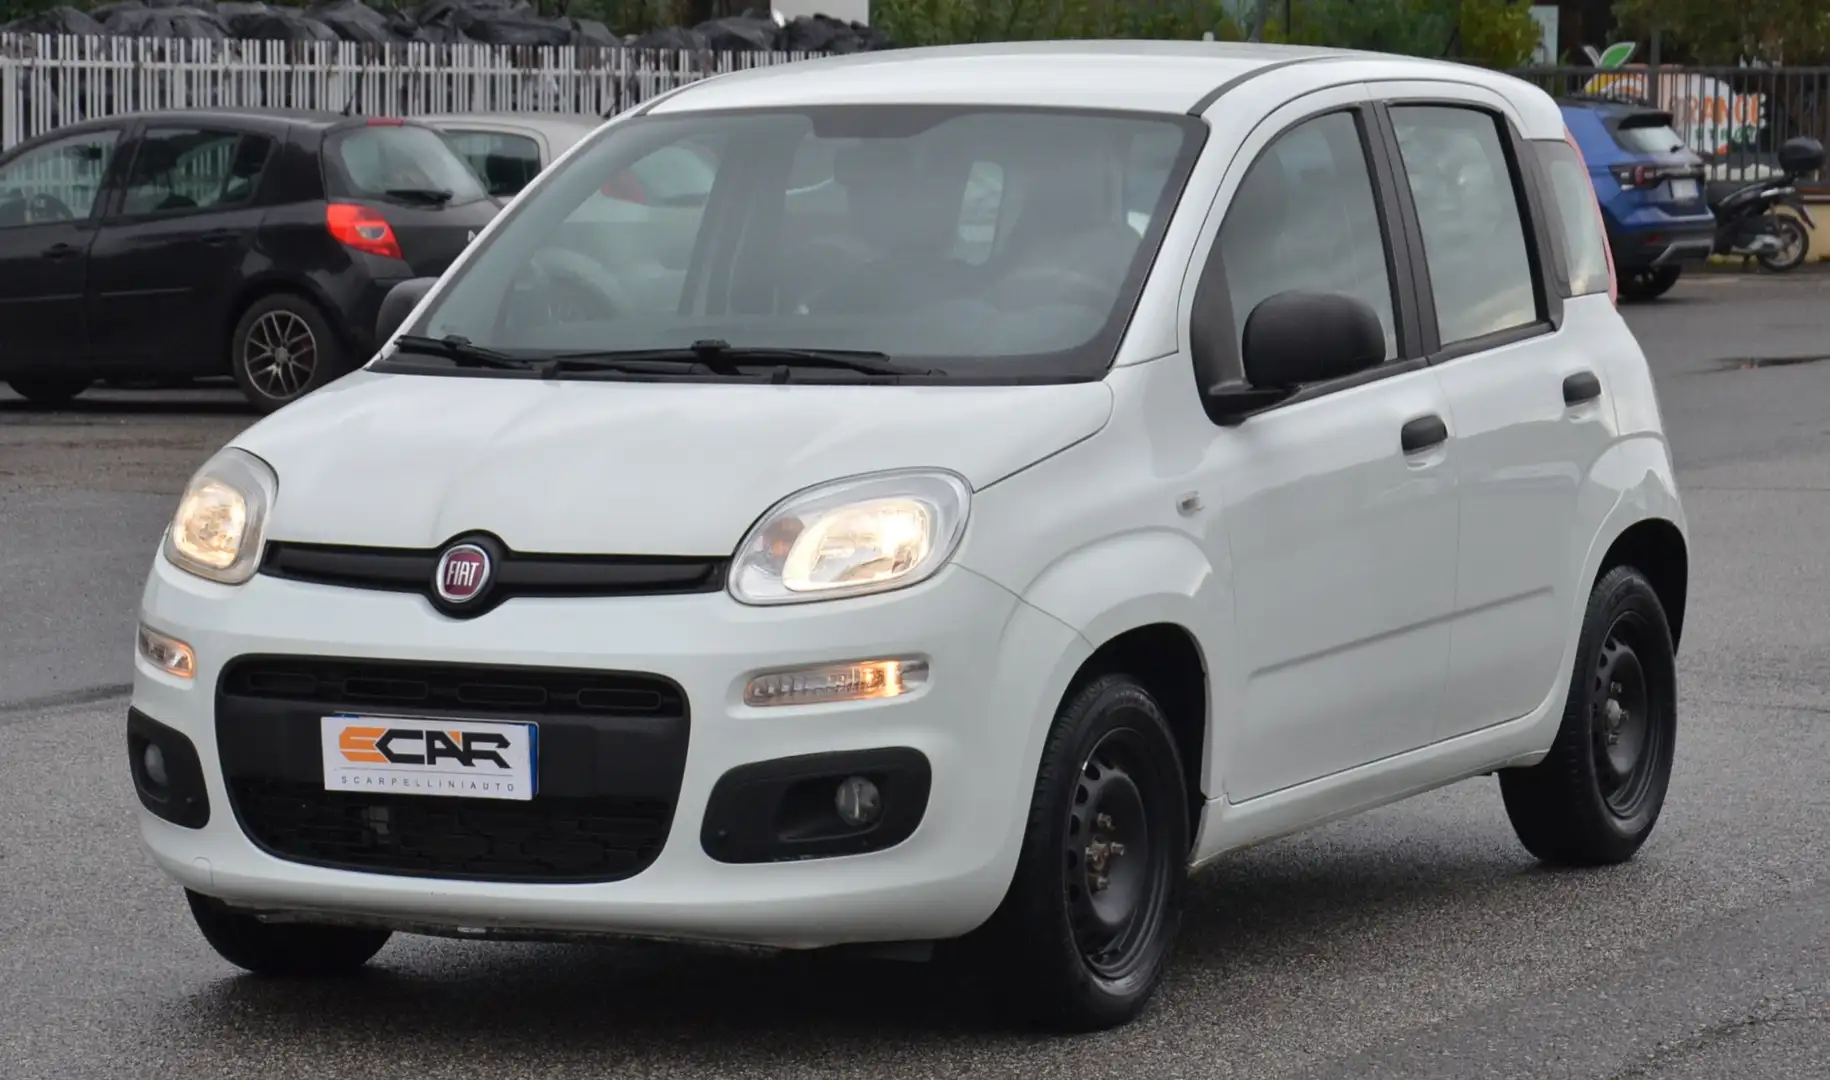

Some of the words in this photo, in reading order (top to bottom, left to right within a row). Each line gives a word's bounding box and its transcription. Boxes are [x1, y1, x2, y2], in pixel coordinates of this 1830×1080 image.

[446, 560, 480, 587] FIAT
[338, 726, 512, 769] ECAR
[341, 775, 514, 792] SCARPELLINIAUTO
